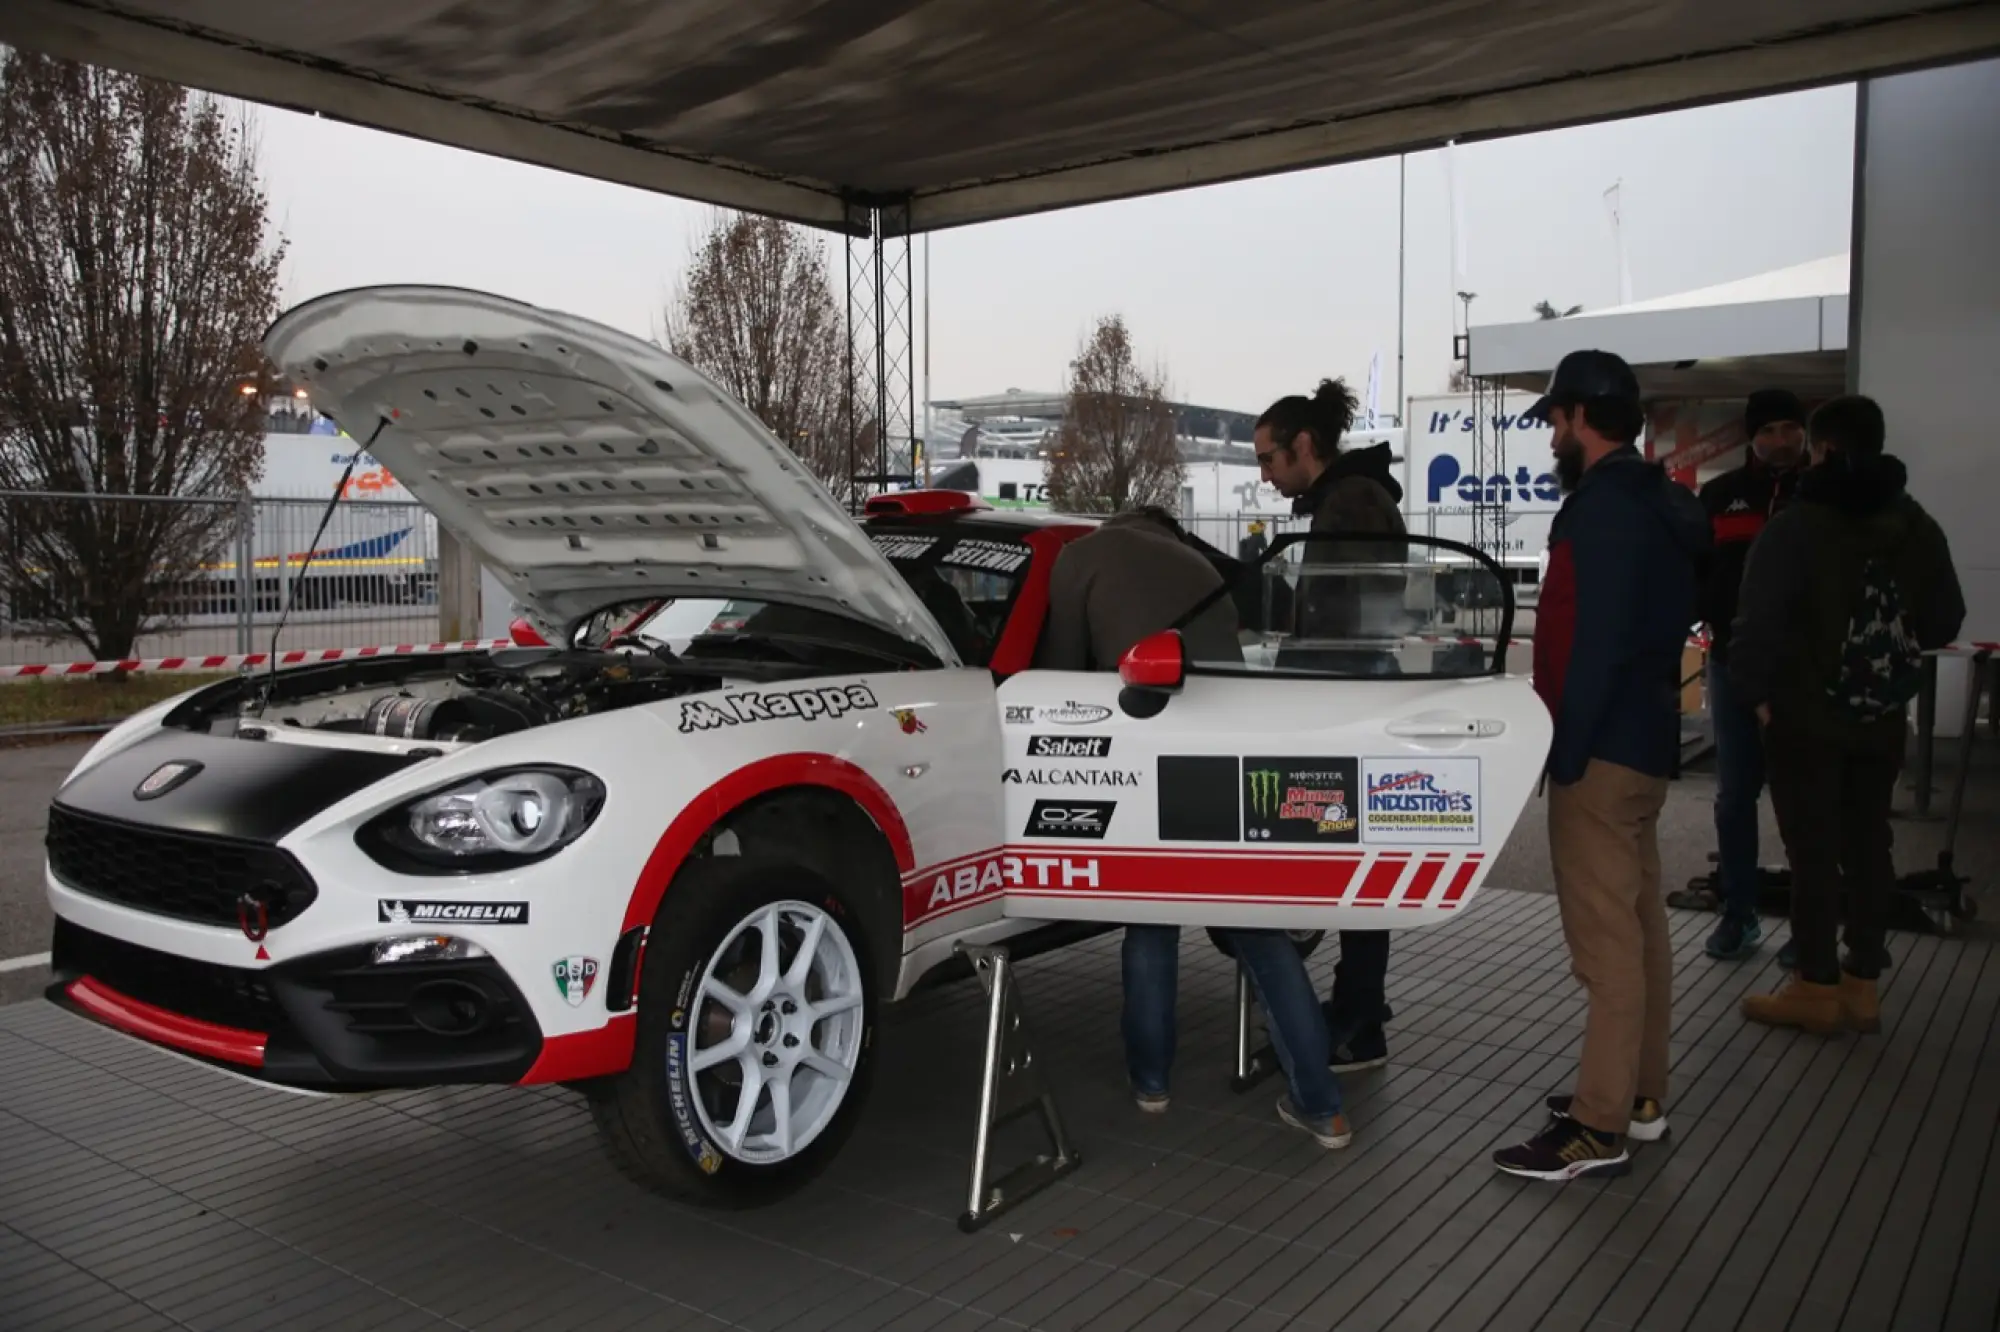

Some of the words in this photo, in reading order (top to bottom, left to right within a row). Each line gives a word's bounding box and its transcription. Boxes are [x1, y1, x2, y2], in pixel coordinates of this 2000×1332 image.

[1429, 410, 1475, 434] It's
[1427, 453, 1561, 503] Panta
[725, 684, 879, 722] Kappa
[1036, 737, 1102, 756] Sabelt
[1026, 769, 1138, 786] ALCANTARA
[1289, 771, 1344, 780] MONSTER
[414, 904, 521, 919] MICHELIN
